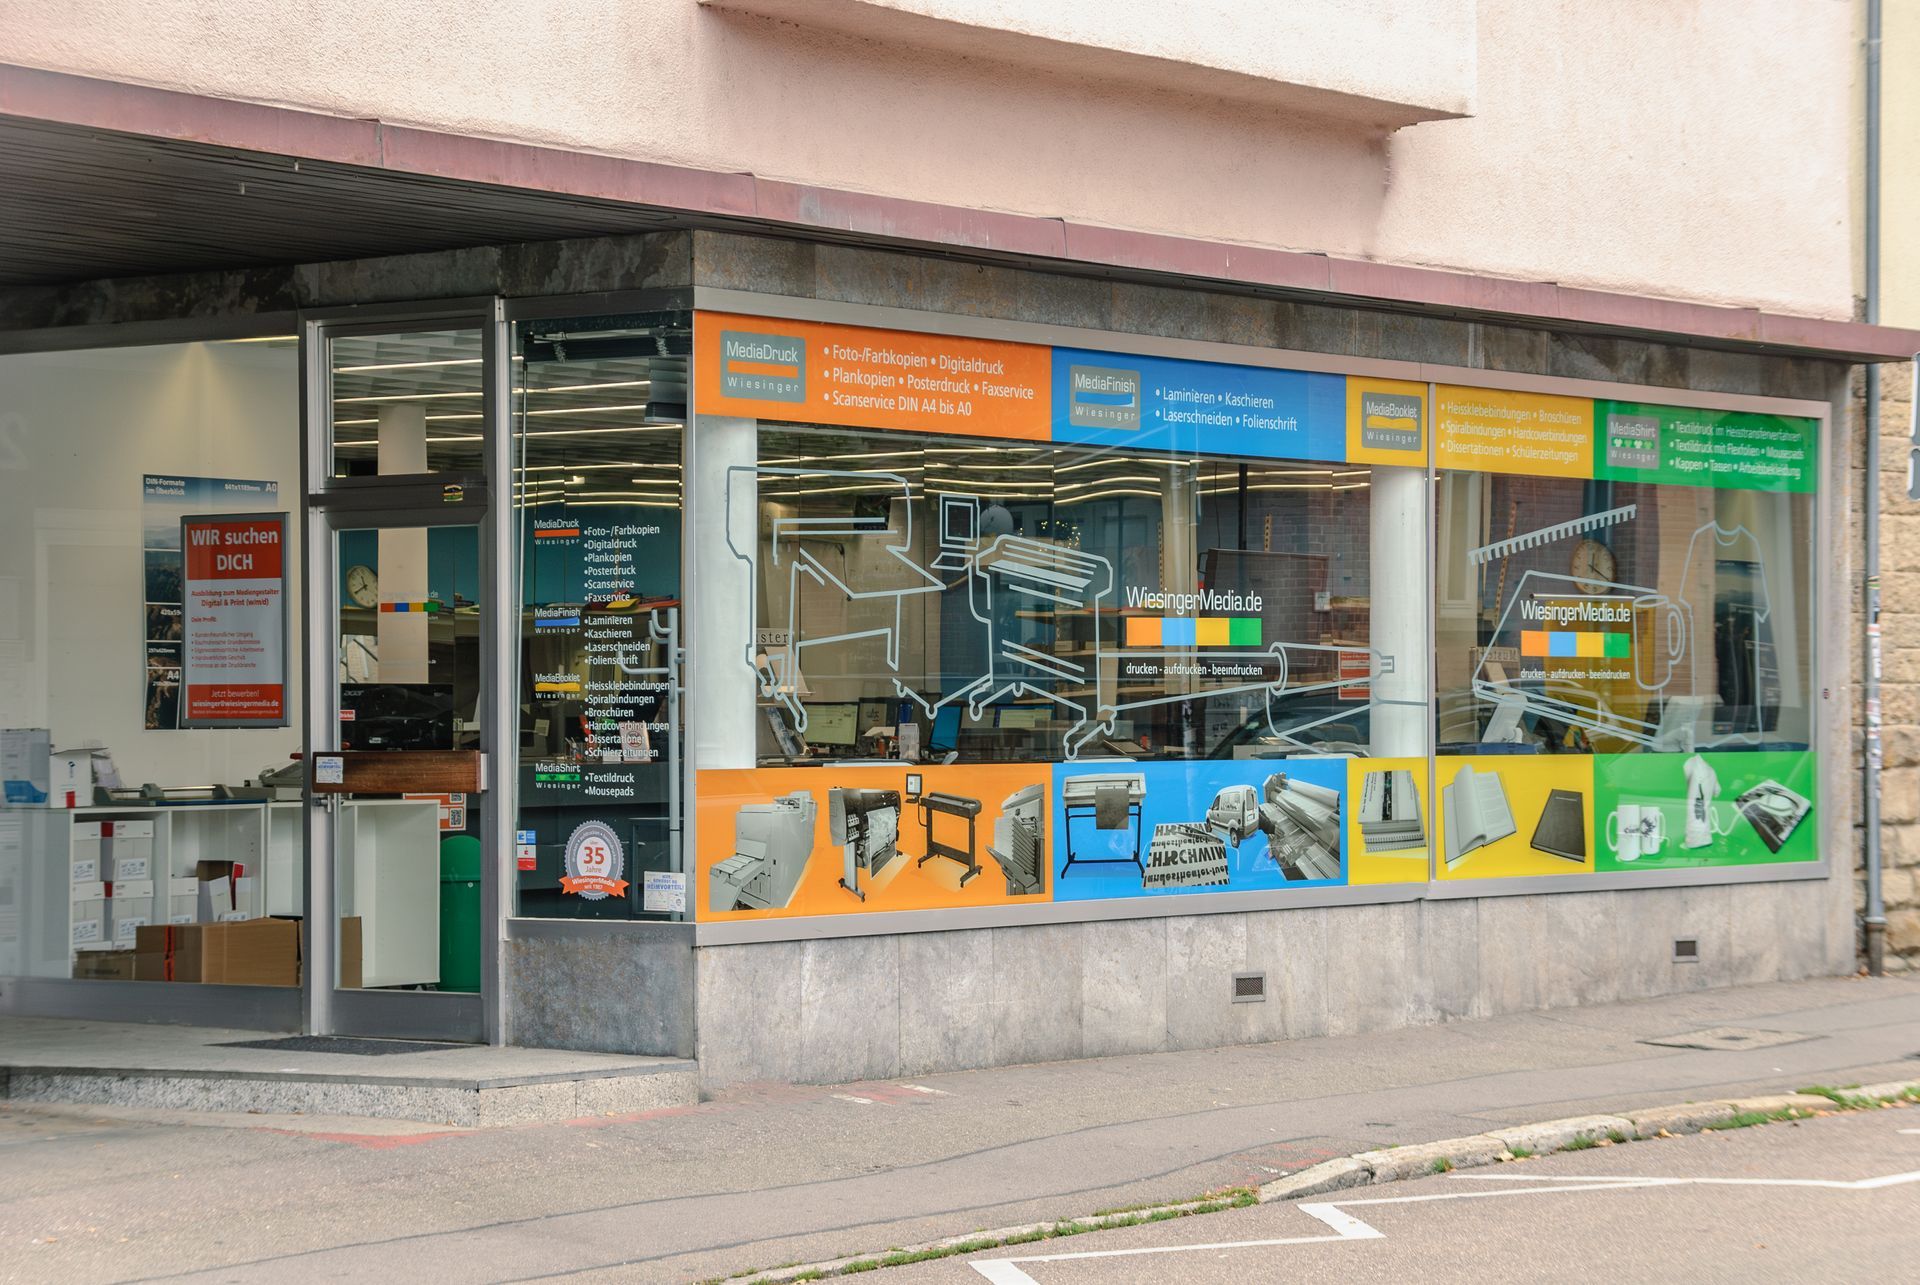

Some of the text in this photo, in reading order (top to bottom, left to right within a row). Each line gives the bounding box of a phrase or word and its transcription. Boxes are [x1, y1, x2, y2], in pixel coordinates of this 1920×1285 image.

[727, 341, 798, 362] MediaDruck
[832, 346, 1004, 376] Foto-/Farbkopien Digitaldruck
[728, 376, 799, 394] Wiesinger
[833, 368, 1034, 400] Plankopien Posterdruck Faxservice
[1075, 373, 1135, 393] MediaFinish
[832, 390, 972, 416] Scanservice DIN A4 bis A0
[1163, 386, 1274, 409] Laminieren Kaschieren
[1075, 406, 1135, 422] Wiesinger
[1366, 401, 1418, 418] MediaBooklet
[1447, 402, 1582, 424] Heissklebebindungen Broschüren
[1163, 408, 1298, 432] Laserschneiden Folienschrift
[1446, 420, 1588, 444] Spiralbindungen Hardcoverbindungen
[1610, 422, 1656, 438] MediaShirt
[1676, 422, 1714, 436] Textildruck
[1367, 431, 1417, 444] Wiesinger
[1447, 440, 1578, 464] Dissertationen Schülerzeitungen
[1676, 439, 1713, 454] Textildruck
[1714, 444, 1726, 455] mit
[1611, 450, 1656, 462] Wiesinger
[1675, 458, 1703, 472] Kappen
[1710, 460, 1732, 472] Tassen
[266, 483, 277, 493] A0
[534, 518, 580, 529] MediaDruck
[191, 527, 278, 546] WIR suchen
[588, 525, 660, 537] Foto-/Farbkopien
[535, 538, 580, 546] Wiesinger
[588, 538, 637, 552] Digitaldruck
[216, 554, 253, 571] DICH
[588, 552, 632, 564] Plankopien
[588, 565, 636, 576] Posterdruck
[588, 579, 635, 589] Scanservice
[588, 592, 630, 602] Faxservice
[1126, 586, 1262, 615] WiesingerMedia.de
[535, 608, 580, 618] MediaFinish
[1520, 600, 1630, 626] WiesingerMedia.de
[588, 616, 632, 626] Laminieren
[588, 629, 632, 638] Kaschieren
[756, 632, 788, 643] ster
[588, 642, 650, 652] Laserschneiden
[588, 654, 638, 665] Folienschrift
[167, 670, 180, 680] A4
[1126, 662, 1158, 675] drucken
[1164, 663, 1207, 675] aufdrucken
[1212, 664, 1262, 676] beeindrucken
[1520, 668, 1546, 679] drucken
[1550, 669, 1586, 679] aufdrucken
[1590, 669, 1630, 680] beeindrucken
[535, 673, 580, 682] MediaBooklet
[588, 681, 670, 692] Heissklebebindungen
[536, 692, 580, 700] Wiesinger
[588, 694, 654, 706] Spiralbindungen
[588, 707, 634, 718] Broschüren
[588, 720, 670, 733] Hardcoverbindungen
[588, 734, 648, 744] Dissertatione
[536, 763, 581, 772] MediaShirt
[588, 772, 635, 783] Textildruck
[536, 782, 580, 790] Wiesinger
[588, 786, 634, 797] Mousepads
[584, 846, 604, 865] 35
[586, 866, 602, 874] Jahre
